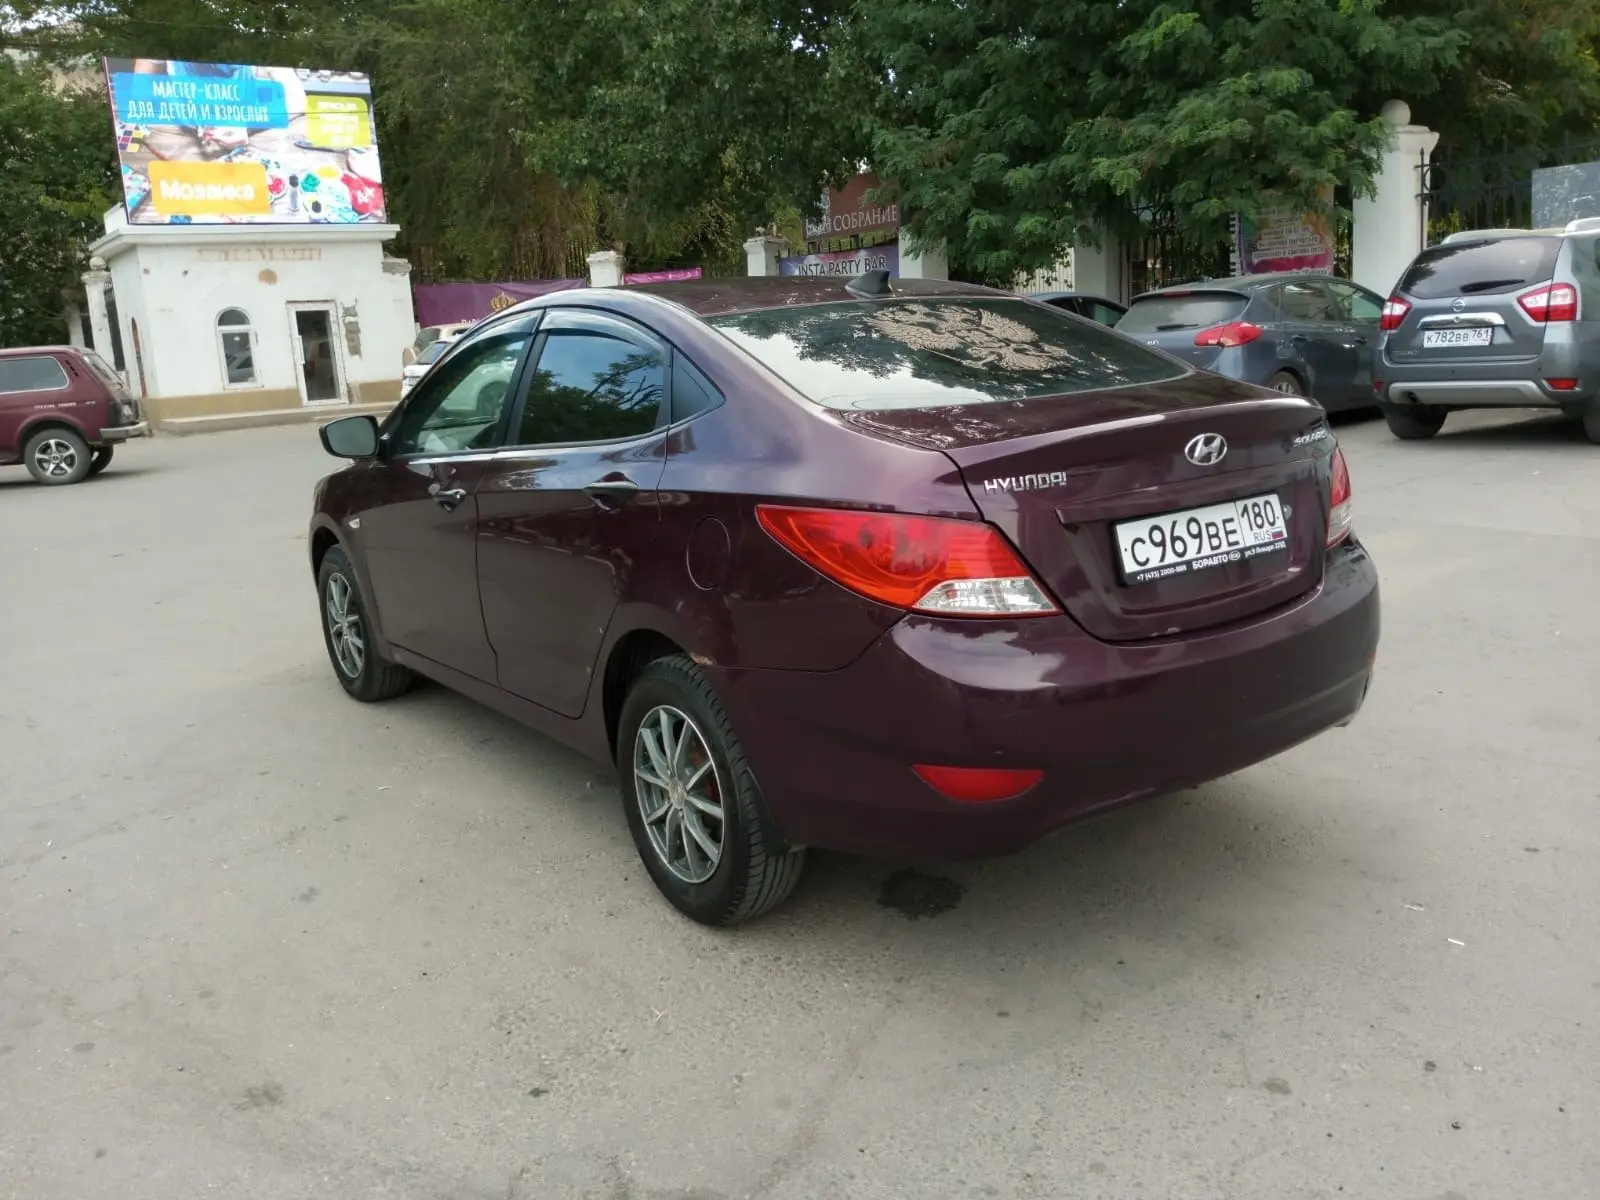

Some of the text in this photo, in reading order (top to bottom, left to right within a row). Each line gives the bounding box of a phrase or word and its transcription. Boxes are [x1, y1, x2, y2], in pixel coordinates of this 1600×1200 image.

[152, 81, 240, 101] МАСТЕР-КЛАСС
[127, 100, 269, 122] ДЛЯ ДЕТЕЙ И ВЗРОСЛЫХ
[833, 204, 898, 232] СОБРАНИЕ
[828, 259, 861, 276] PARTY
[864, 255, 887, 272] BAR
[983, 471, 1067, 495] HYUNDAI
[1241, 500, 1276, 531] 180
[1253, 530, 1272, 541] RUS
[1192, 554, 1229, 570] БОРАВТО
